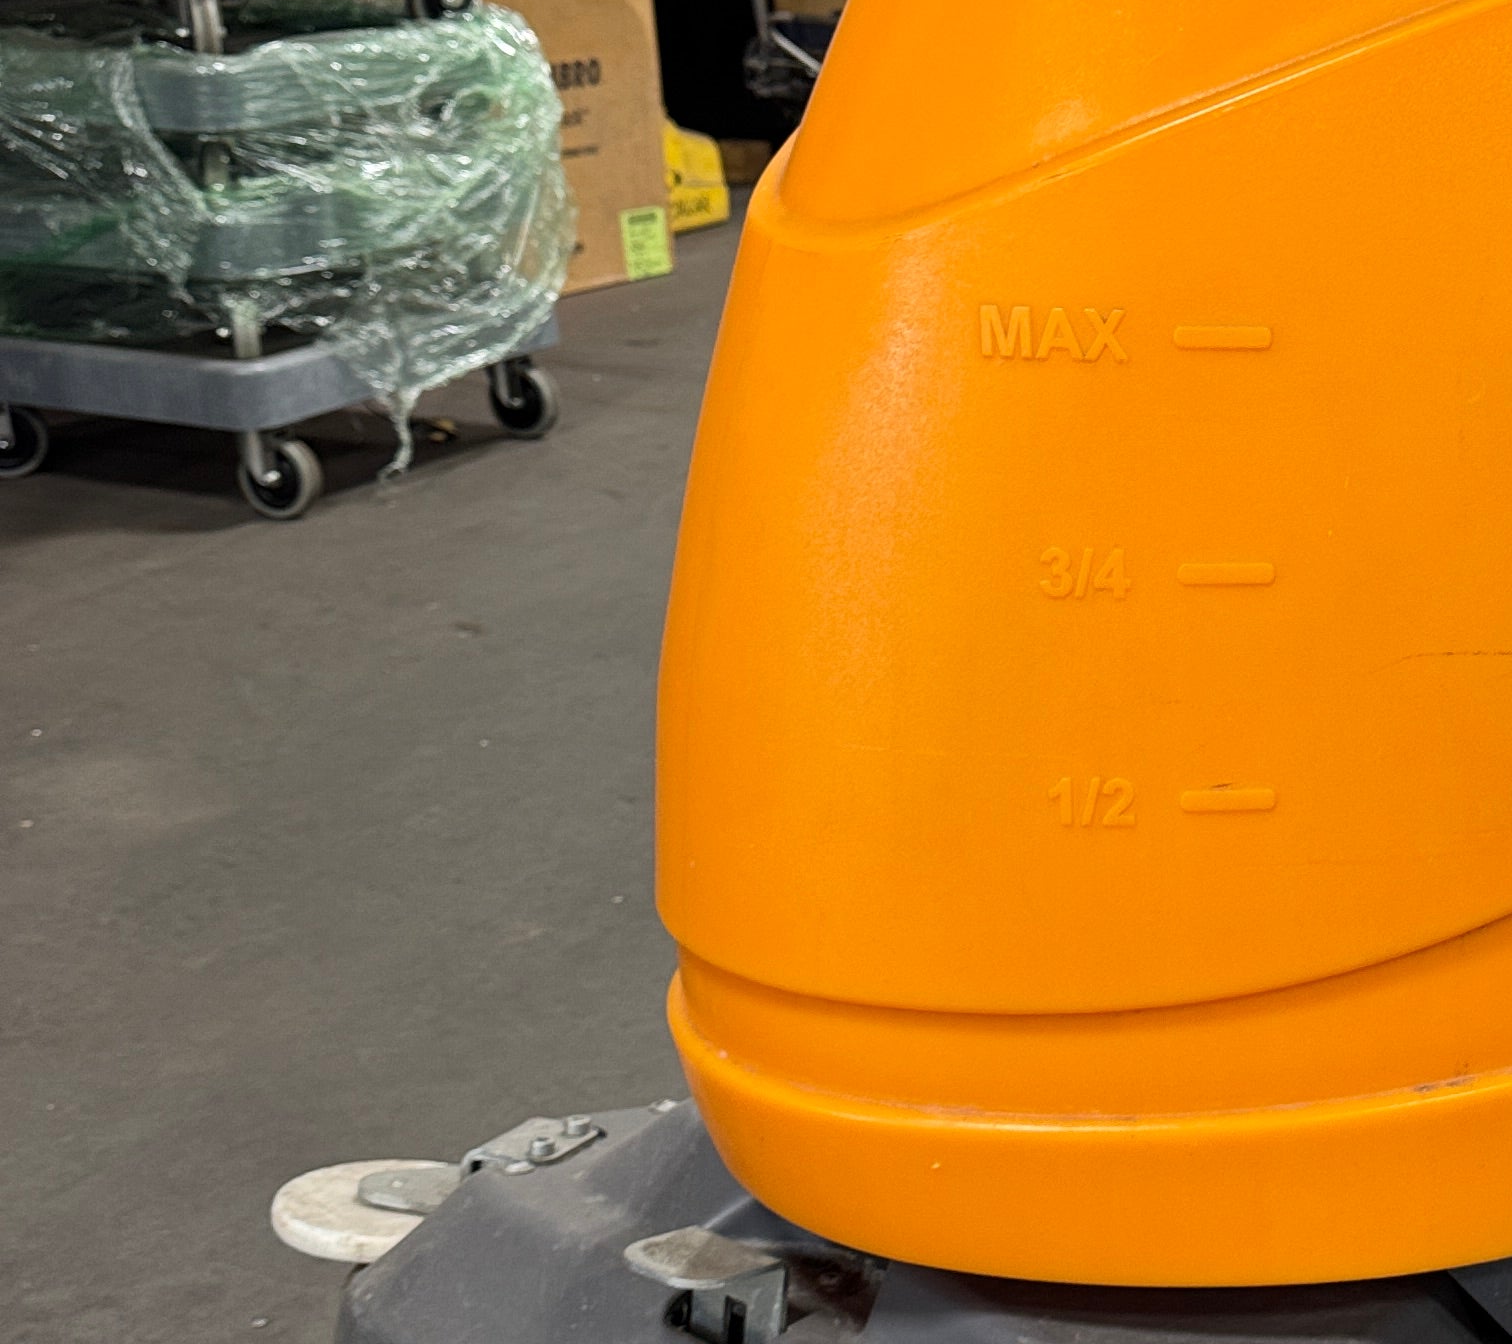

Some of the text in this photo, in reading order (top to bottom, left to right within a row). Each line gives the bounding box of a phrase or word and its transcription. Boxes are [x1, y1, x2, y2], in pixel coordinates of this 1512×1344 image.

[979, 304, 1128, 362] MAX
[1039, 546, 1131, 600] 3/4
[1048, 776, 1136, 828] 1/2
